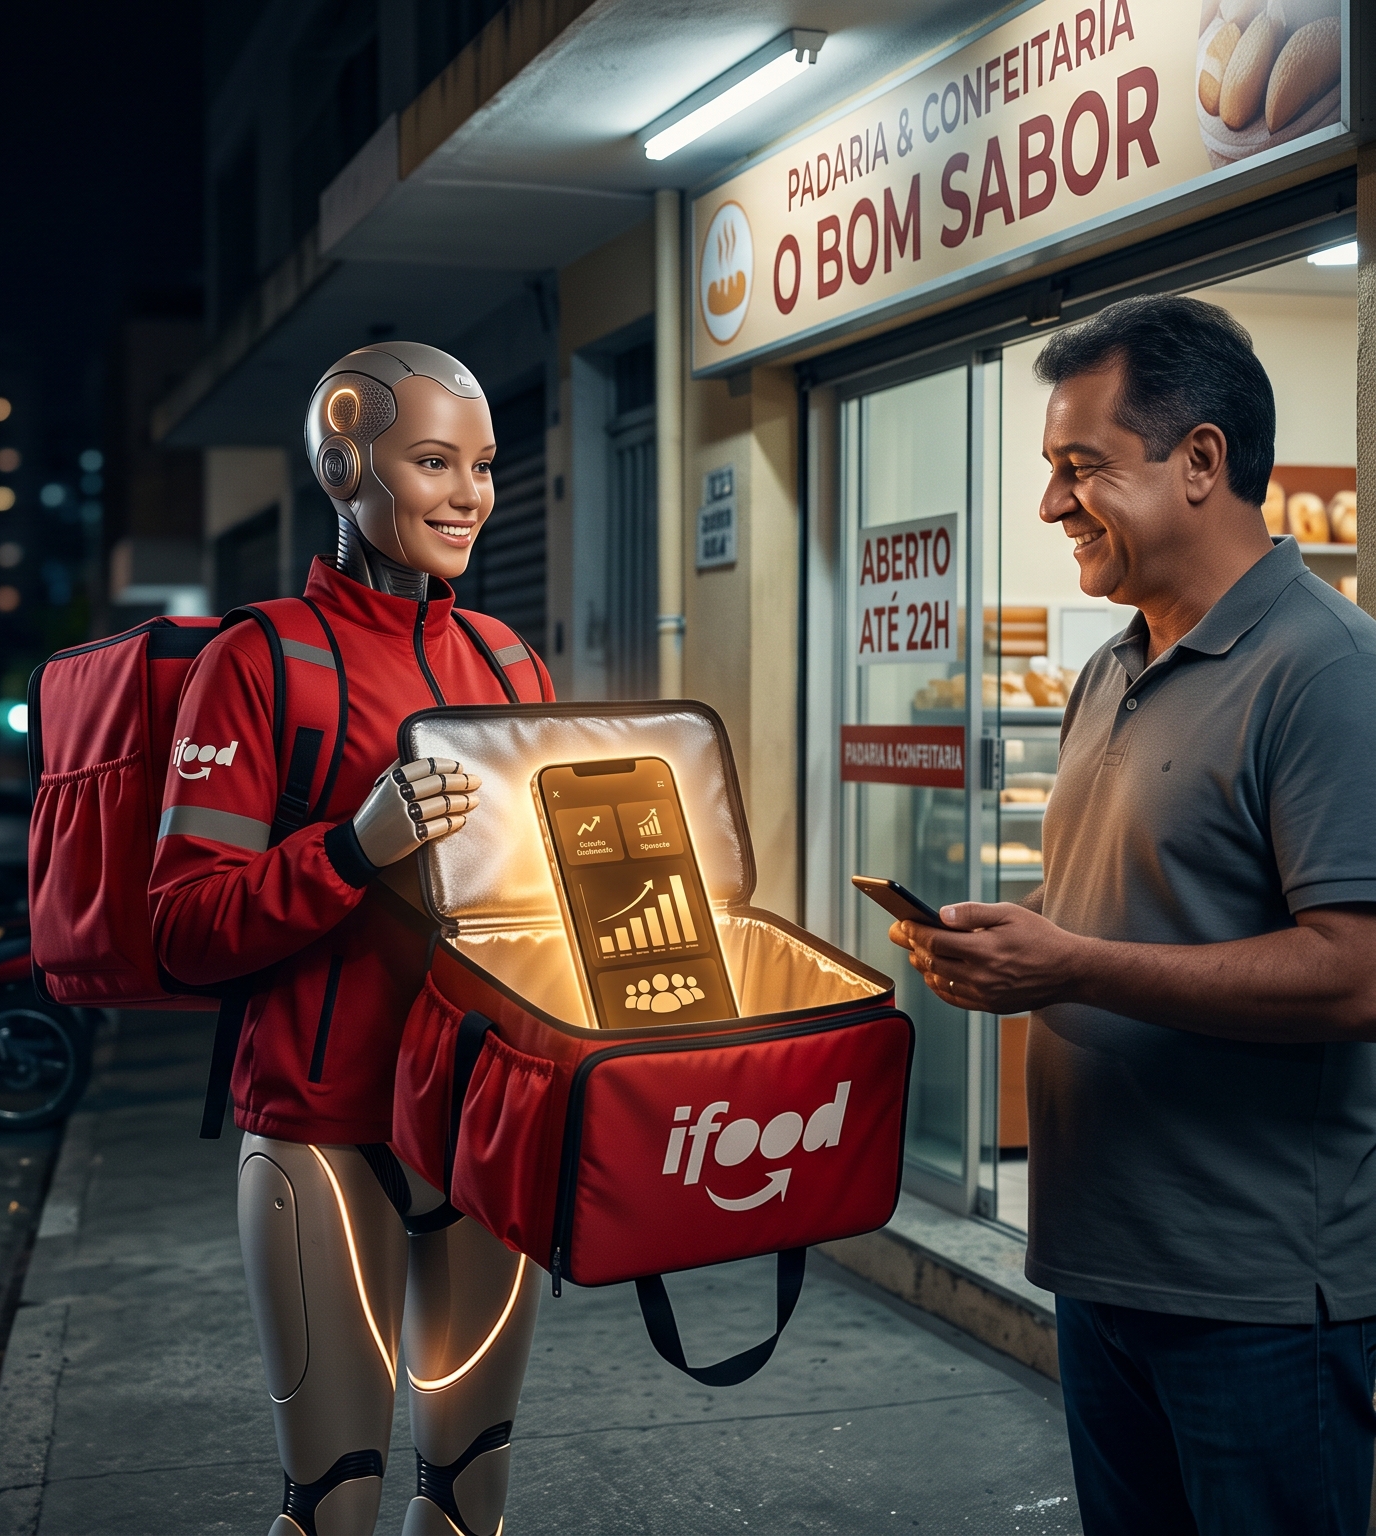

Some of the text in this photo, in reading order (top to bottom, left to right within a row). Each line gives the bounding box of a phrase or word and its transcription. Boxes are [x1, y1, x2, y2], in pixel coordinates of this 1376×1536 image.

[788, 0, 1135, 212] PADARIA & CONFEITARIA
[773, 66, 1161, 315] O BOM SABOR
[860, 527, 951, 586] ABERTO
[859, 591, 949, 654] ATÉ 22H
[173, 736, 239, 767] ifood
[845, 742, 963, 770] PADARIA & CONFEITARIA
[662, 1080, 851, 1186] ifood
